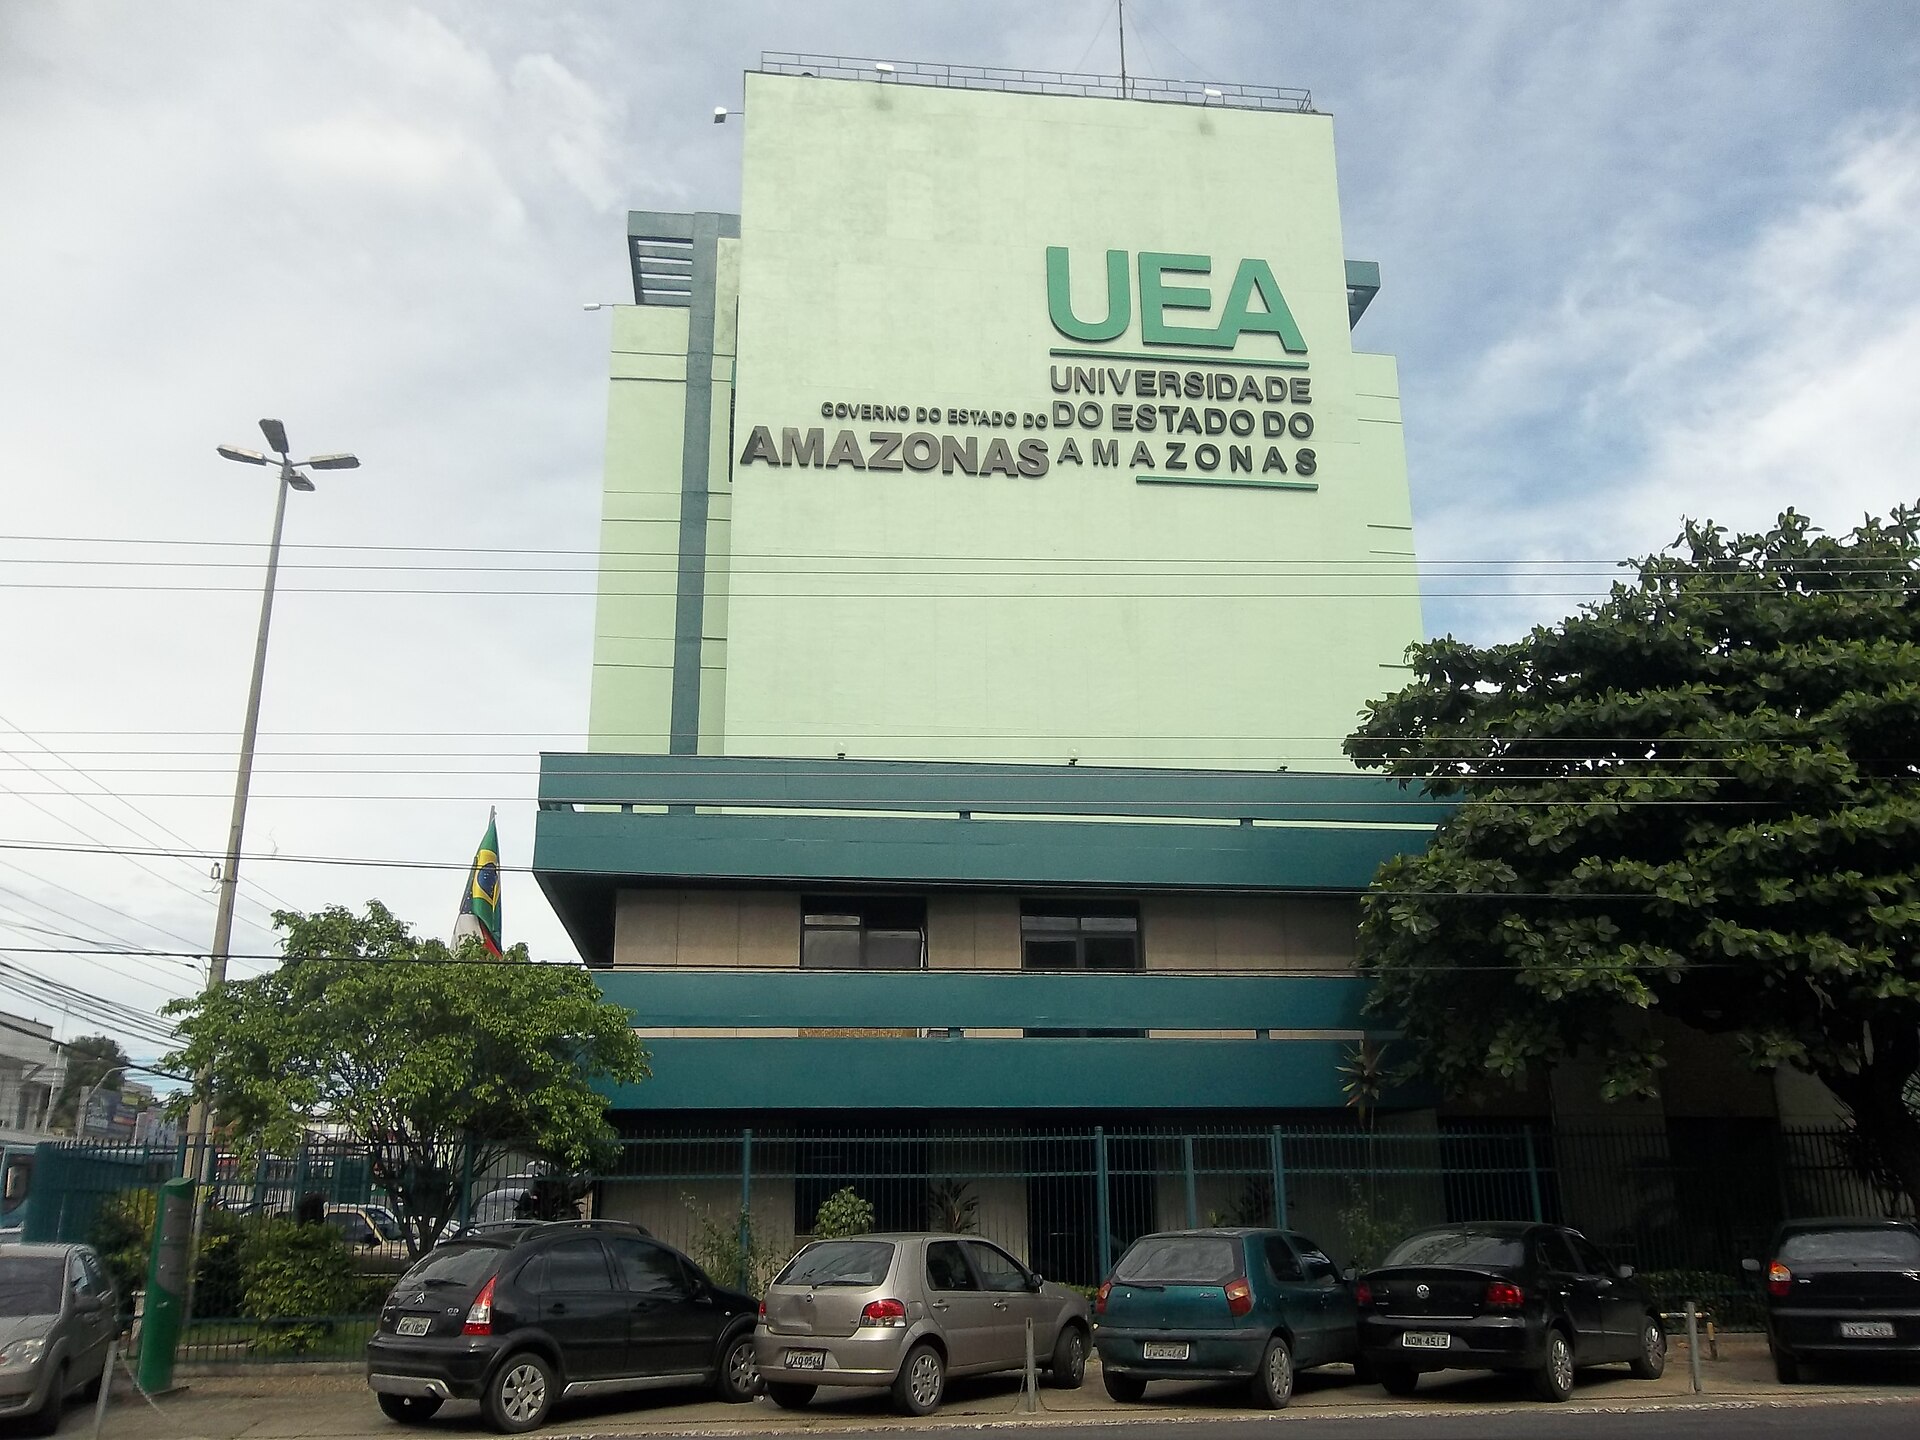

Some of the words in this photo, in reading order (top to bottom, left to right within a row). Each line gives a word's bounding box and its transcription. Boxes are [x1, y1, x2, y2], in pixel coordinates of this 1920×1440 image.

[1046, 246, 1308, 353] UEA
[1050, 365, 1312, 403] UNIVERSIDADE
[822, 402, 910, 421] GOVERNO
[916, 406, 941, 422] DO
[948, 409, 1017, 426] ESTADO
[1023, 412, 1048, 428] DO
[1053, 400, 1103, 428] DO
[1112, 404, 1255, 436] ESTADO
[1263, 411, 1314, 438] DO
[740, 426, 1050, 477] AMAZONAS
[1057, 438, 1317, 476] AMAZONAS
